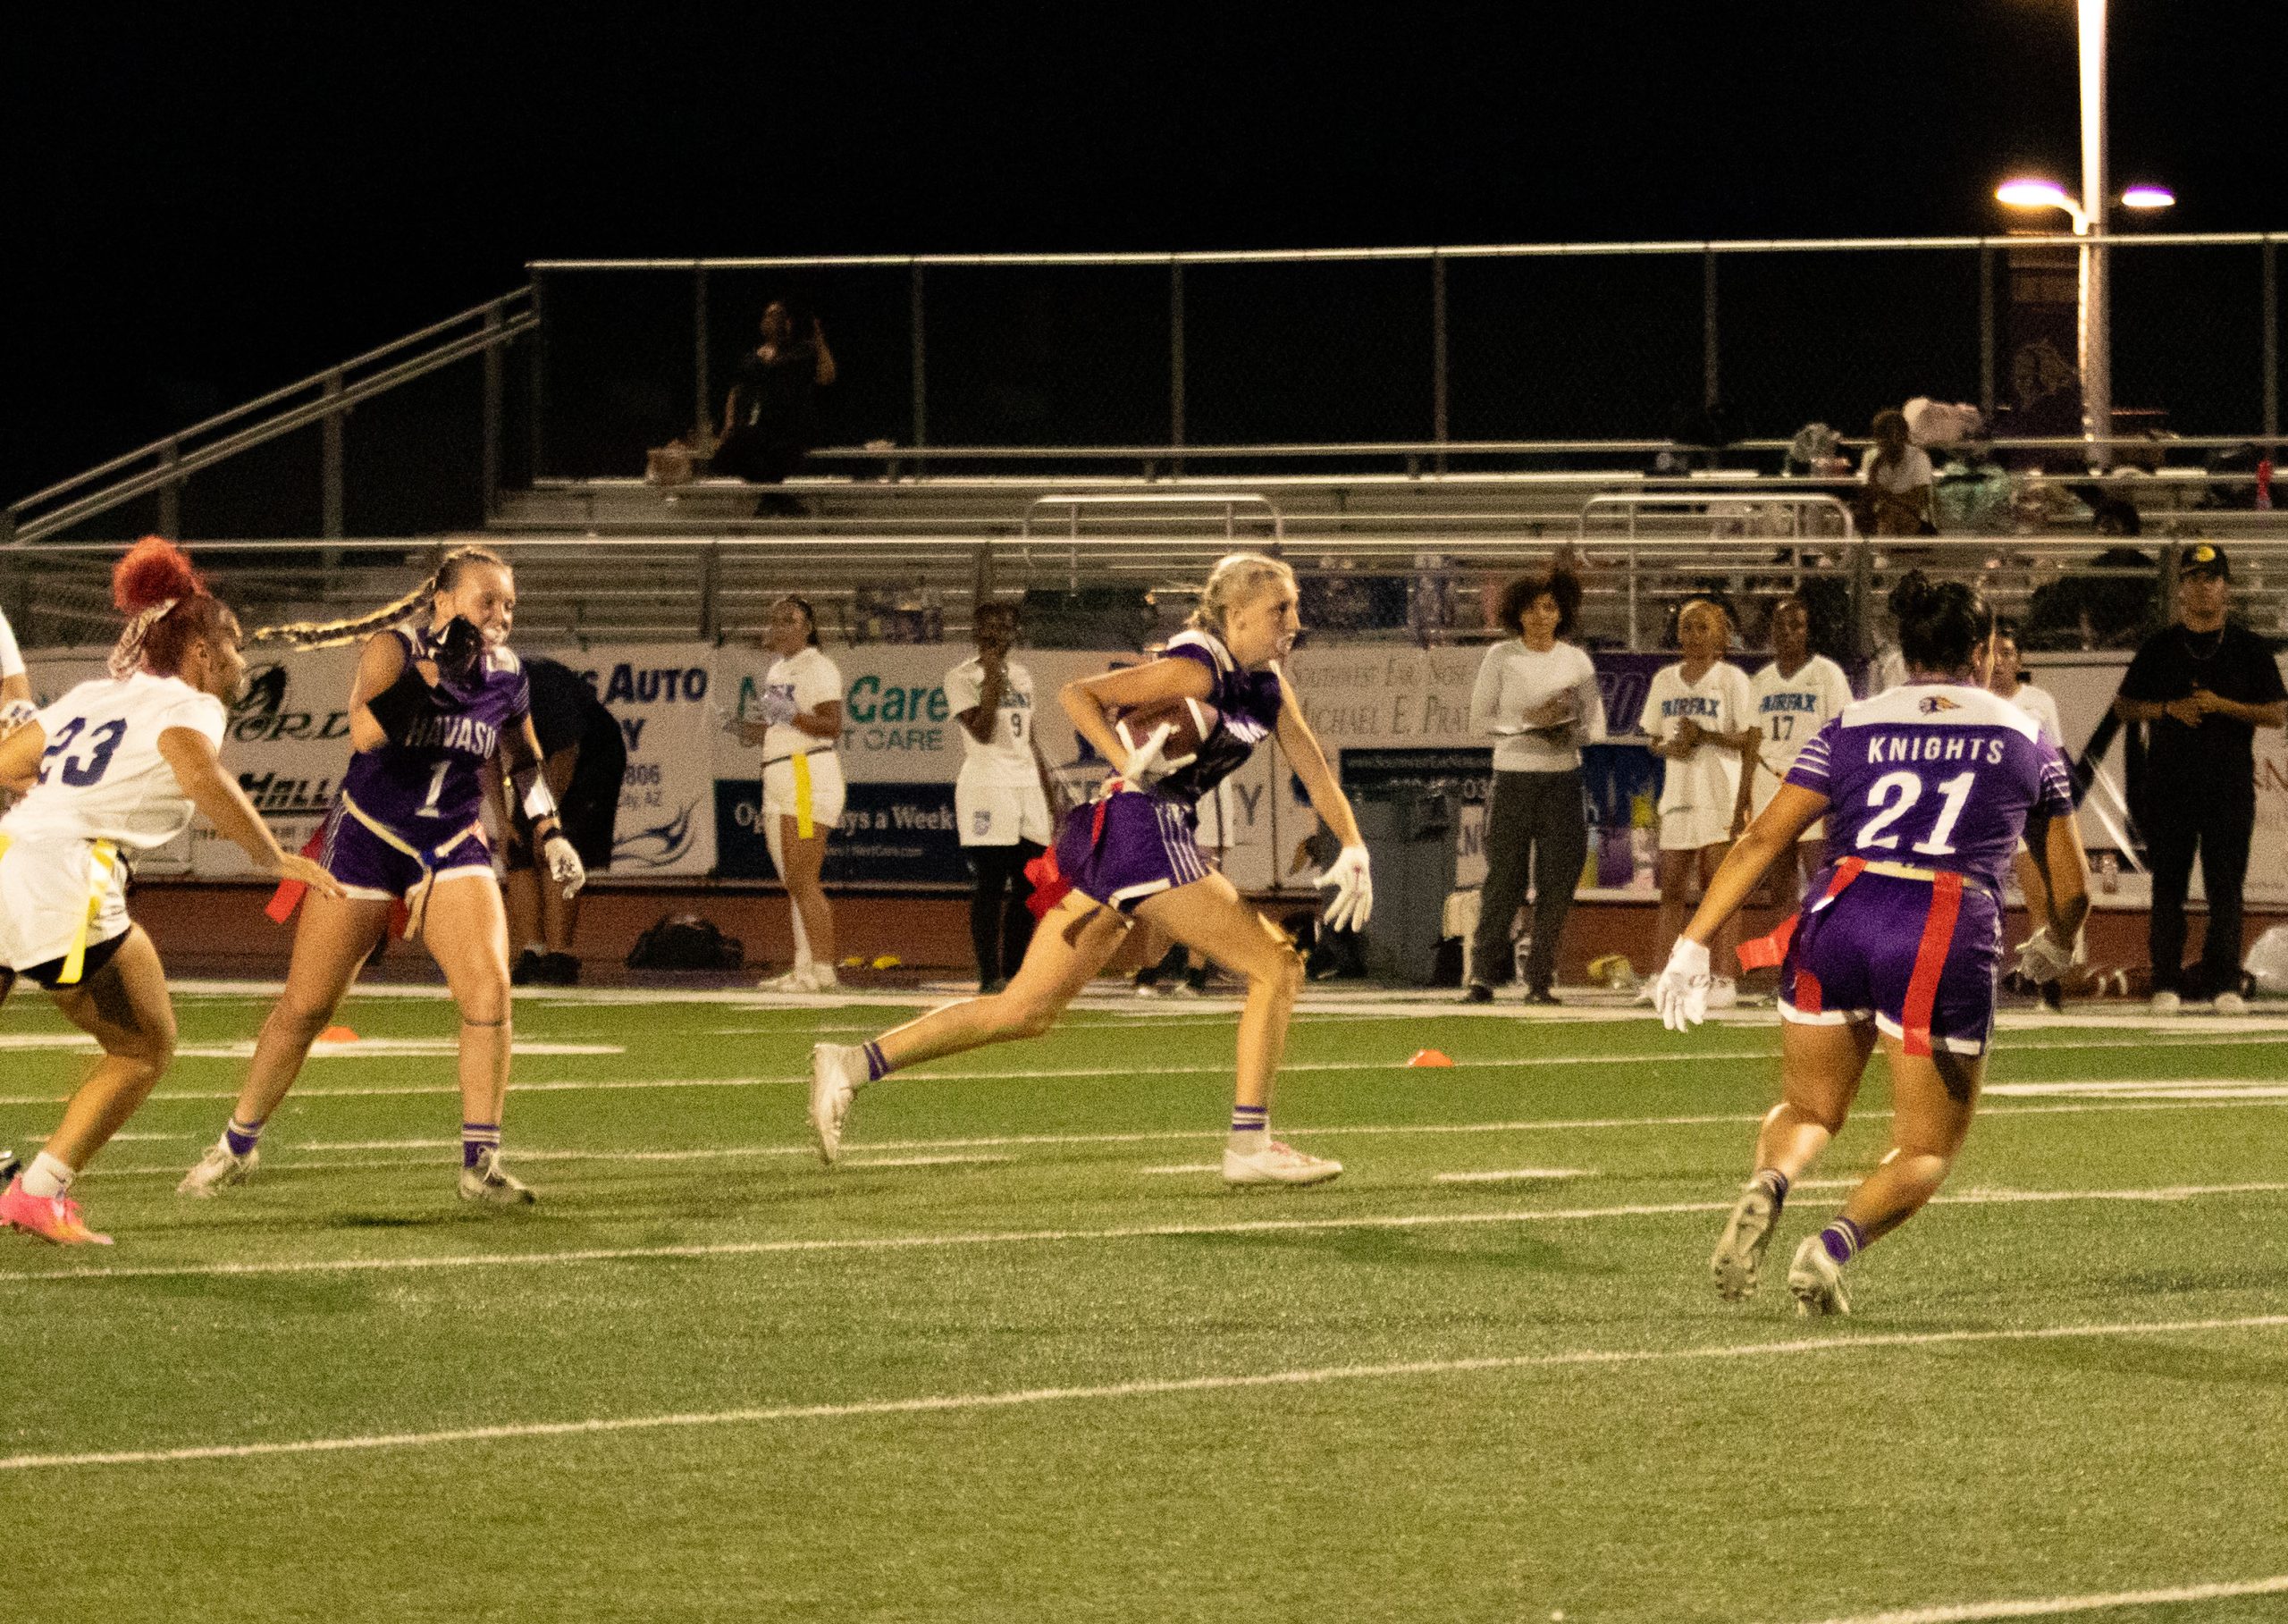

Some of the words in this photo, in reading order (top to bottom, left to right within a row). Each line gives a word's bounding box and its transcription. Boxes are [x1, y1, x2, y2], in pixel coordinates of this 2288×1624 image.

[604, 663, 708, 703] AUTO
[405, 716, 496, 760] HAVASU
[864, 728, 944, 752] CARE
[1011, 713, 1022, 737] 9
[1771, 715, 1794, 742] 17
[38, 717, 128, 787] 23
[1868, 736, 2005, 764] KNIGHTS
[415, 760, 452, 818] 1
[875, 812, 888, 829] a
[891, 803, 955, 830] Week
[1855, 770, 1976, 855] 21
